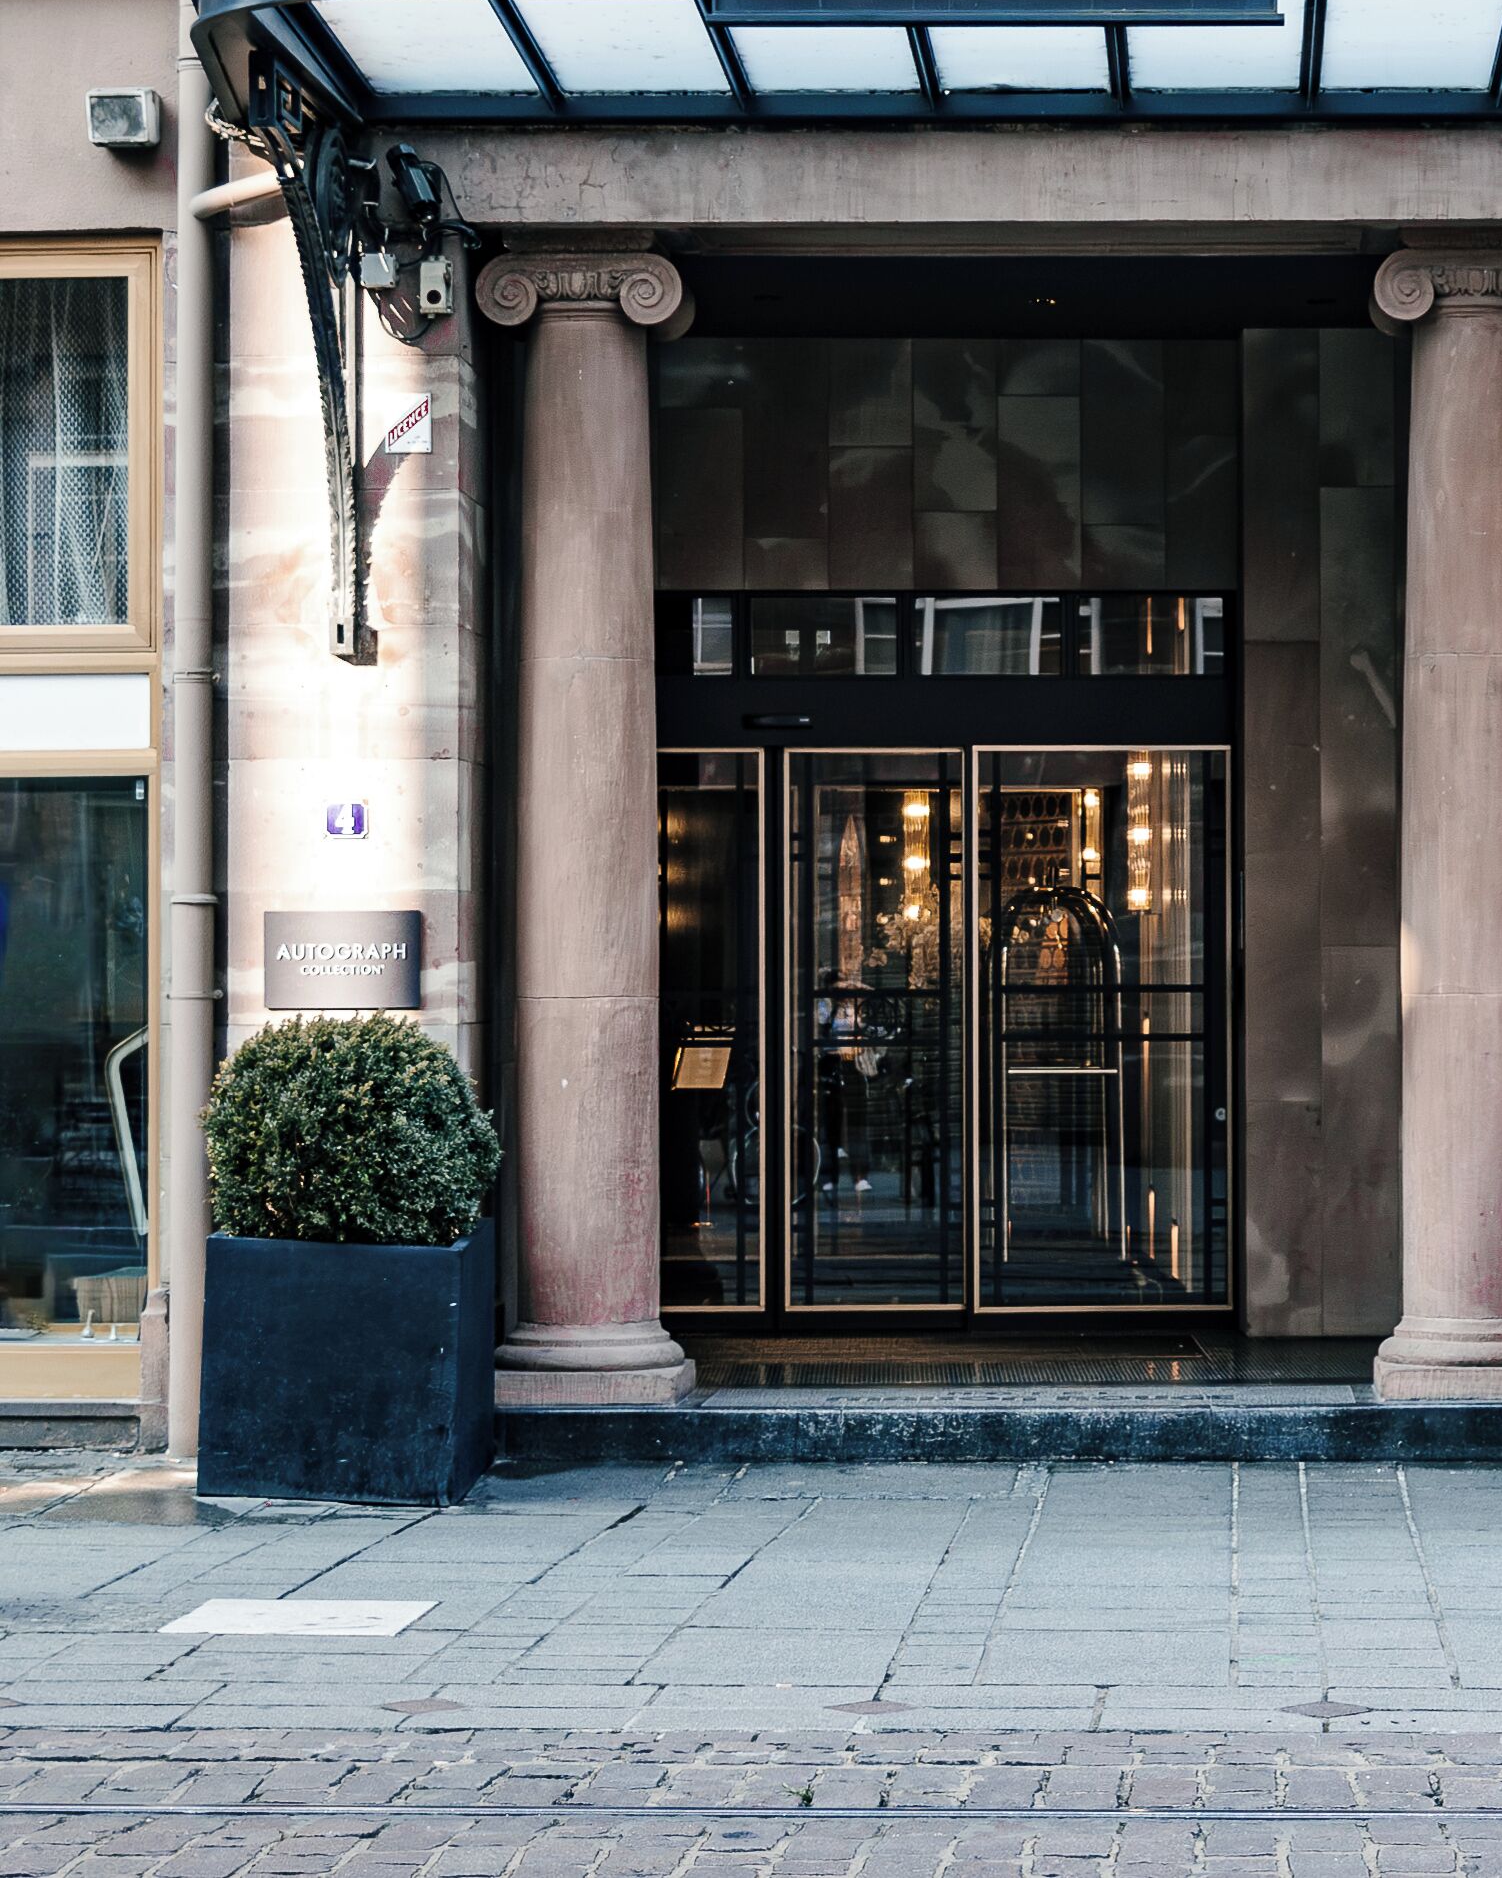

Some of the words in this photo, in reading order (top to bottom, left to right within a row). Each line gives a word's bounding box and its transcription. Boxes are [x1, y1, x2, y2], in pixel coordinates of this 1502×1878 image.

[389, 401, 428, 445] LICENCE
[335, 804, 355, 834] 4
[277, 942, 407, 961] AUTOGRAPH
